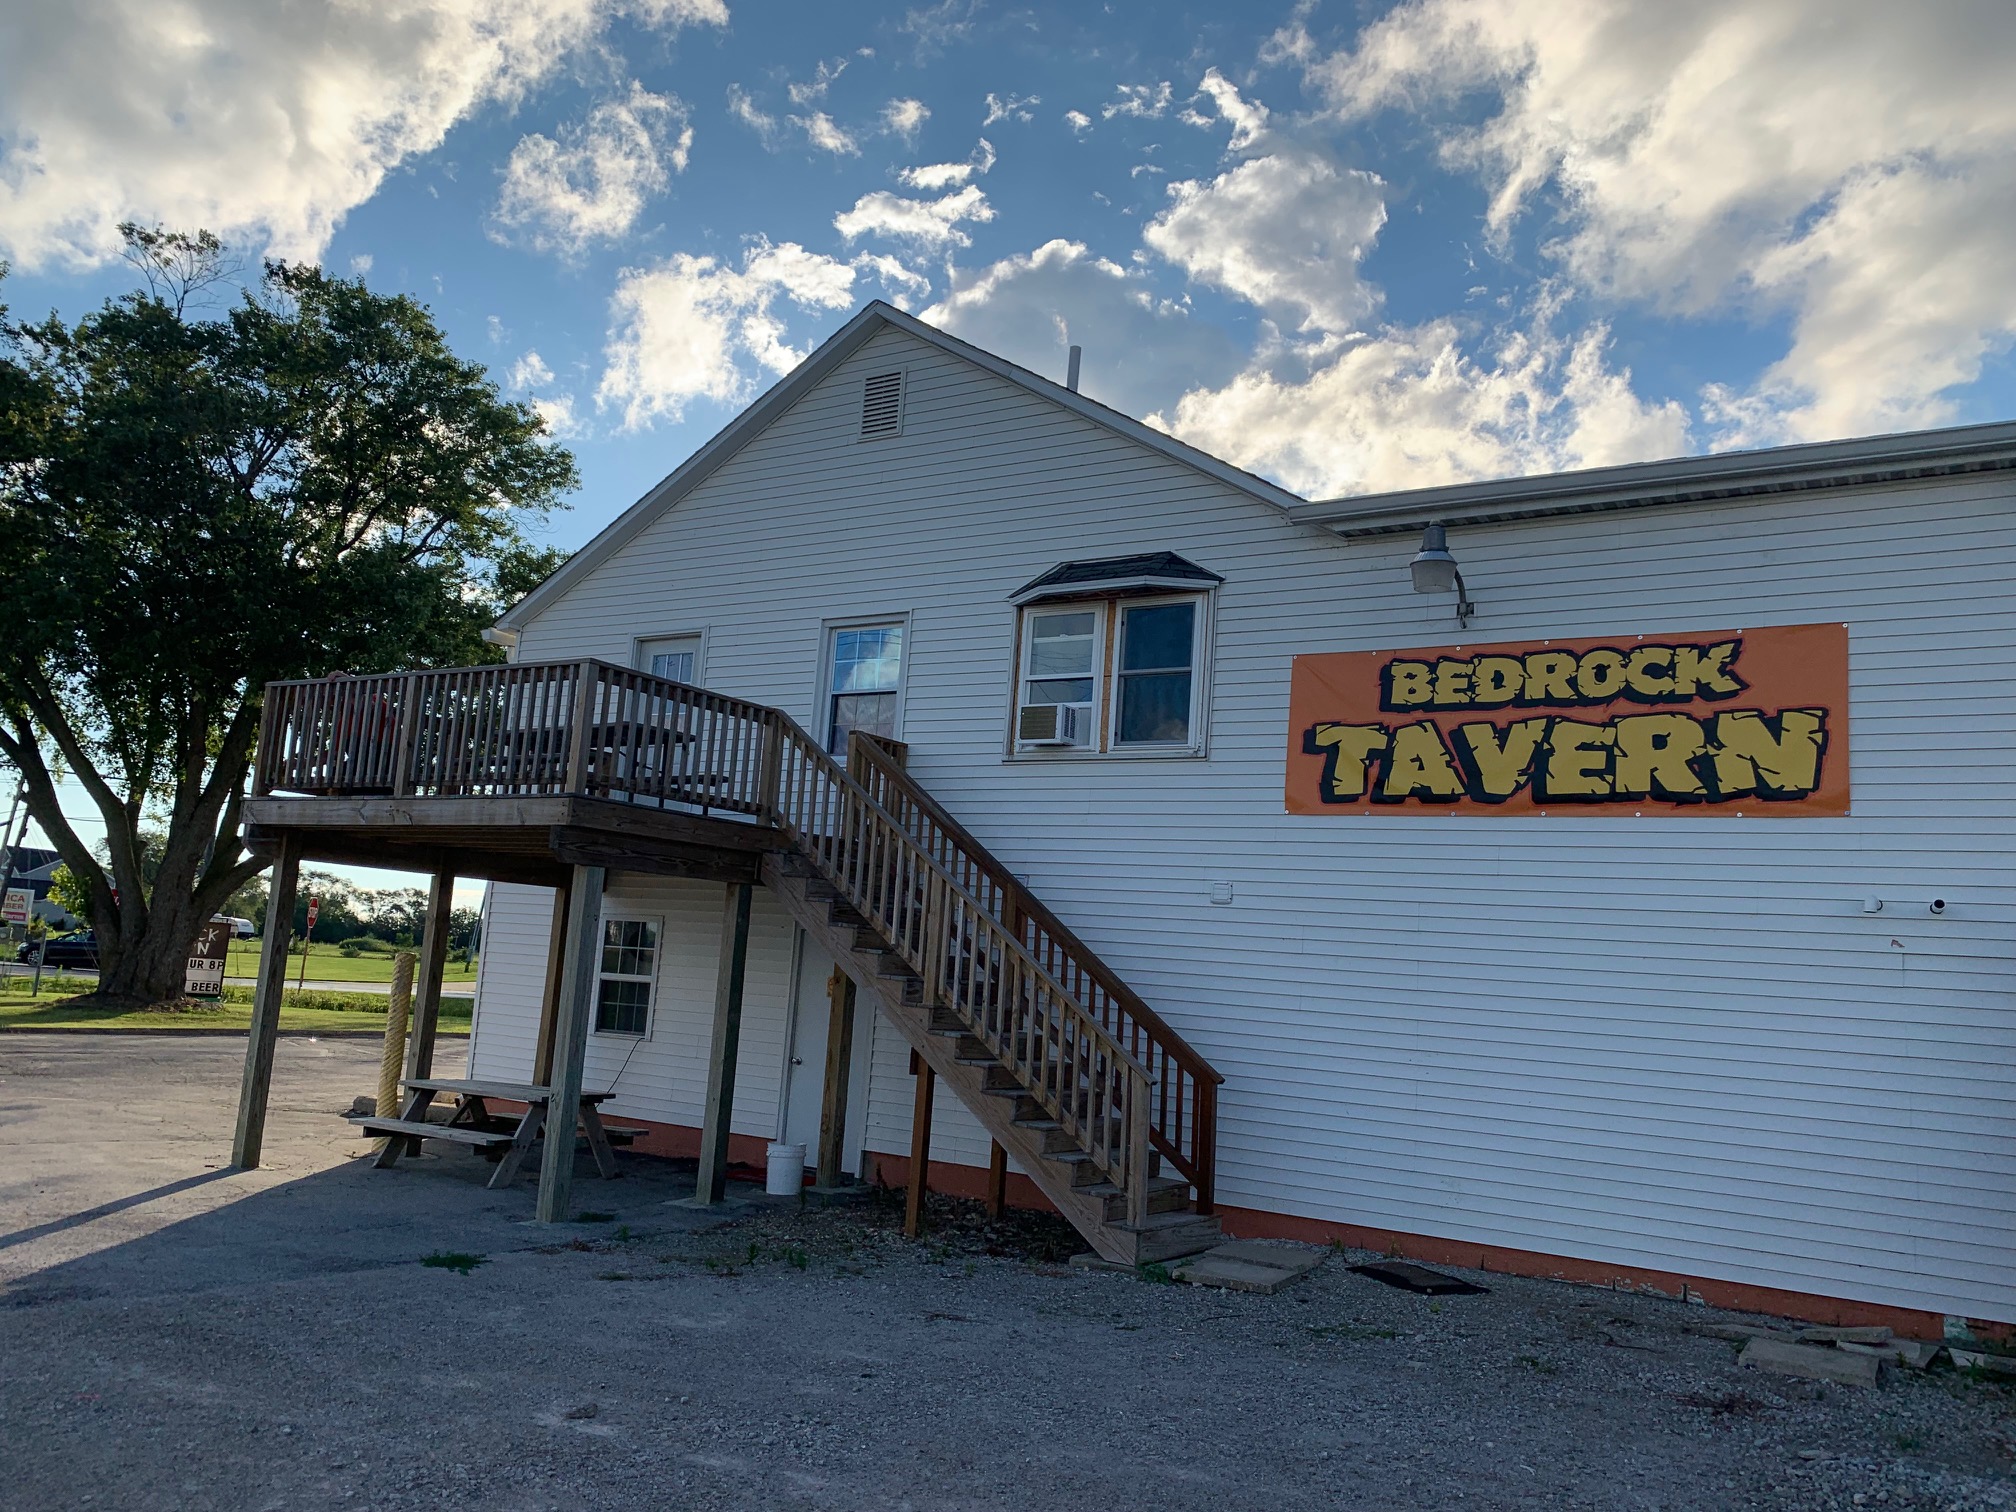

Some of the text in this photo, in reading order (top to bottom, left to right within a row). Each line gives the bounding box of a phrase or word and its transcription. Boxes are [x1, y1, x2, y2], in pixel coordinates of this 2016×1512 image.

[1381, 639, 1750, 711] BEDROCK
[1303, 708, 1829, 803] TAVERN
[191, 982, 219, 993] BEER
